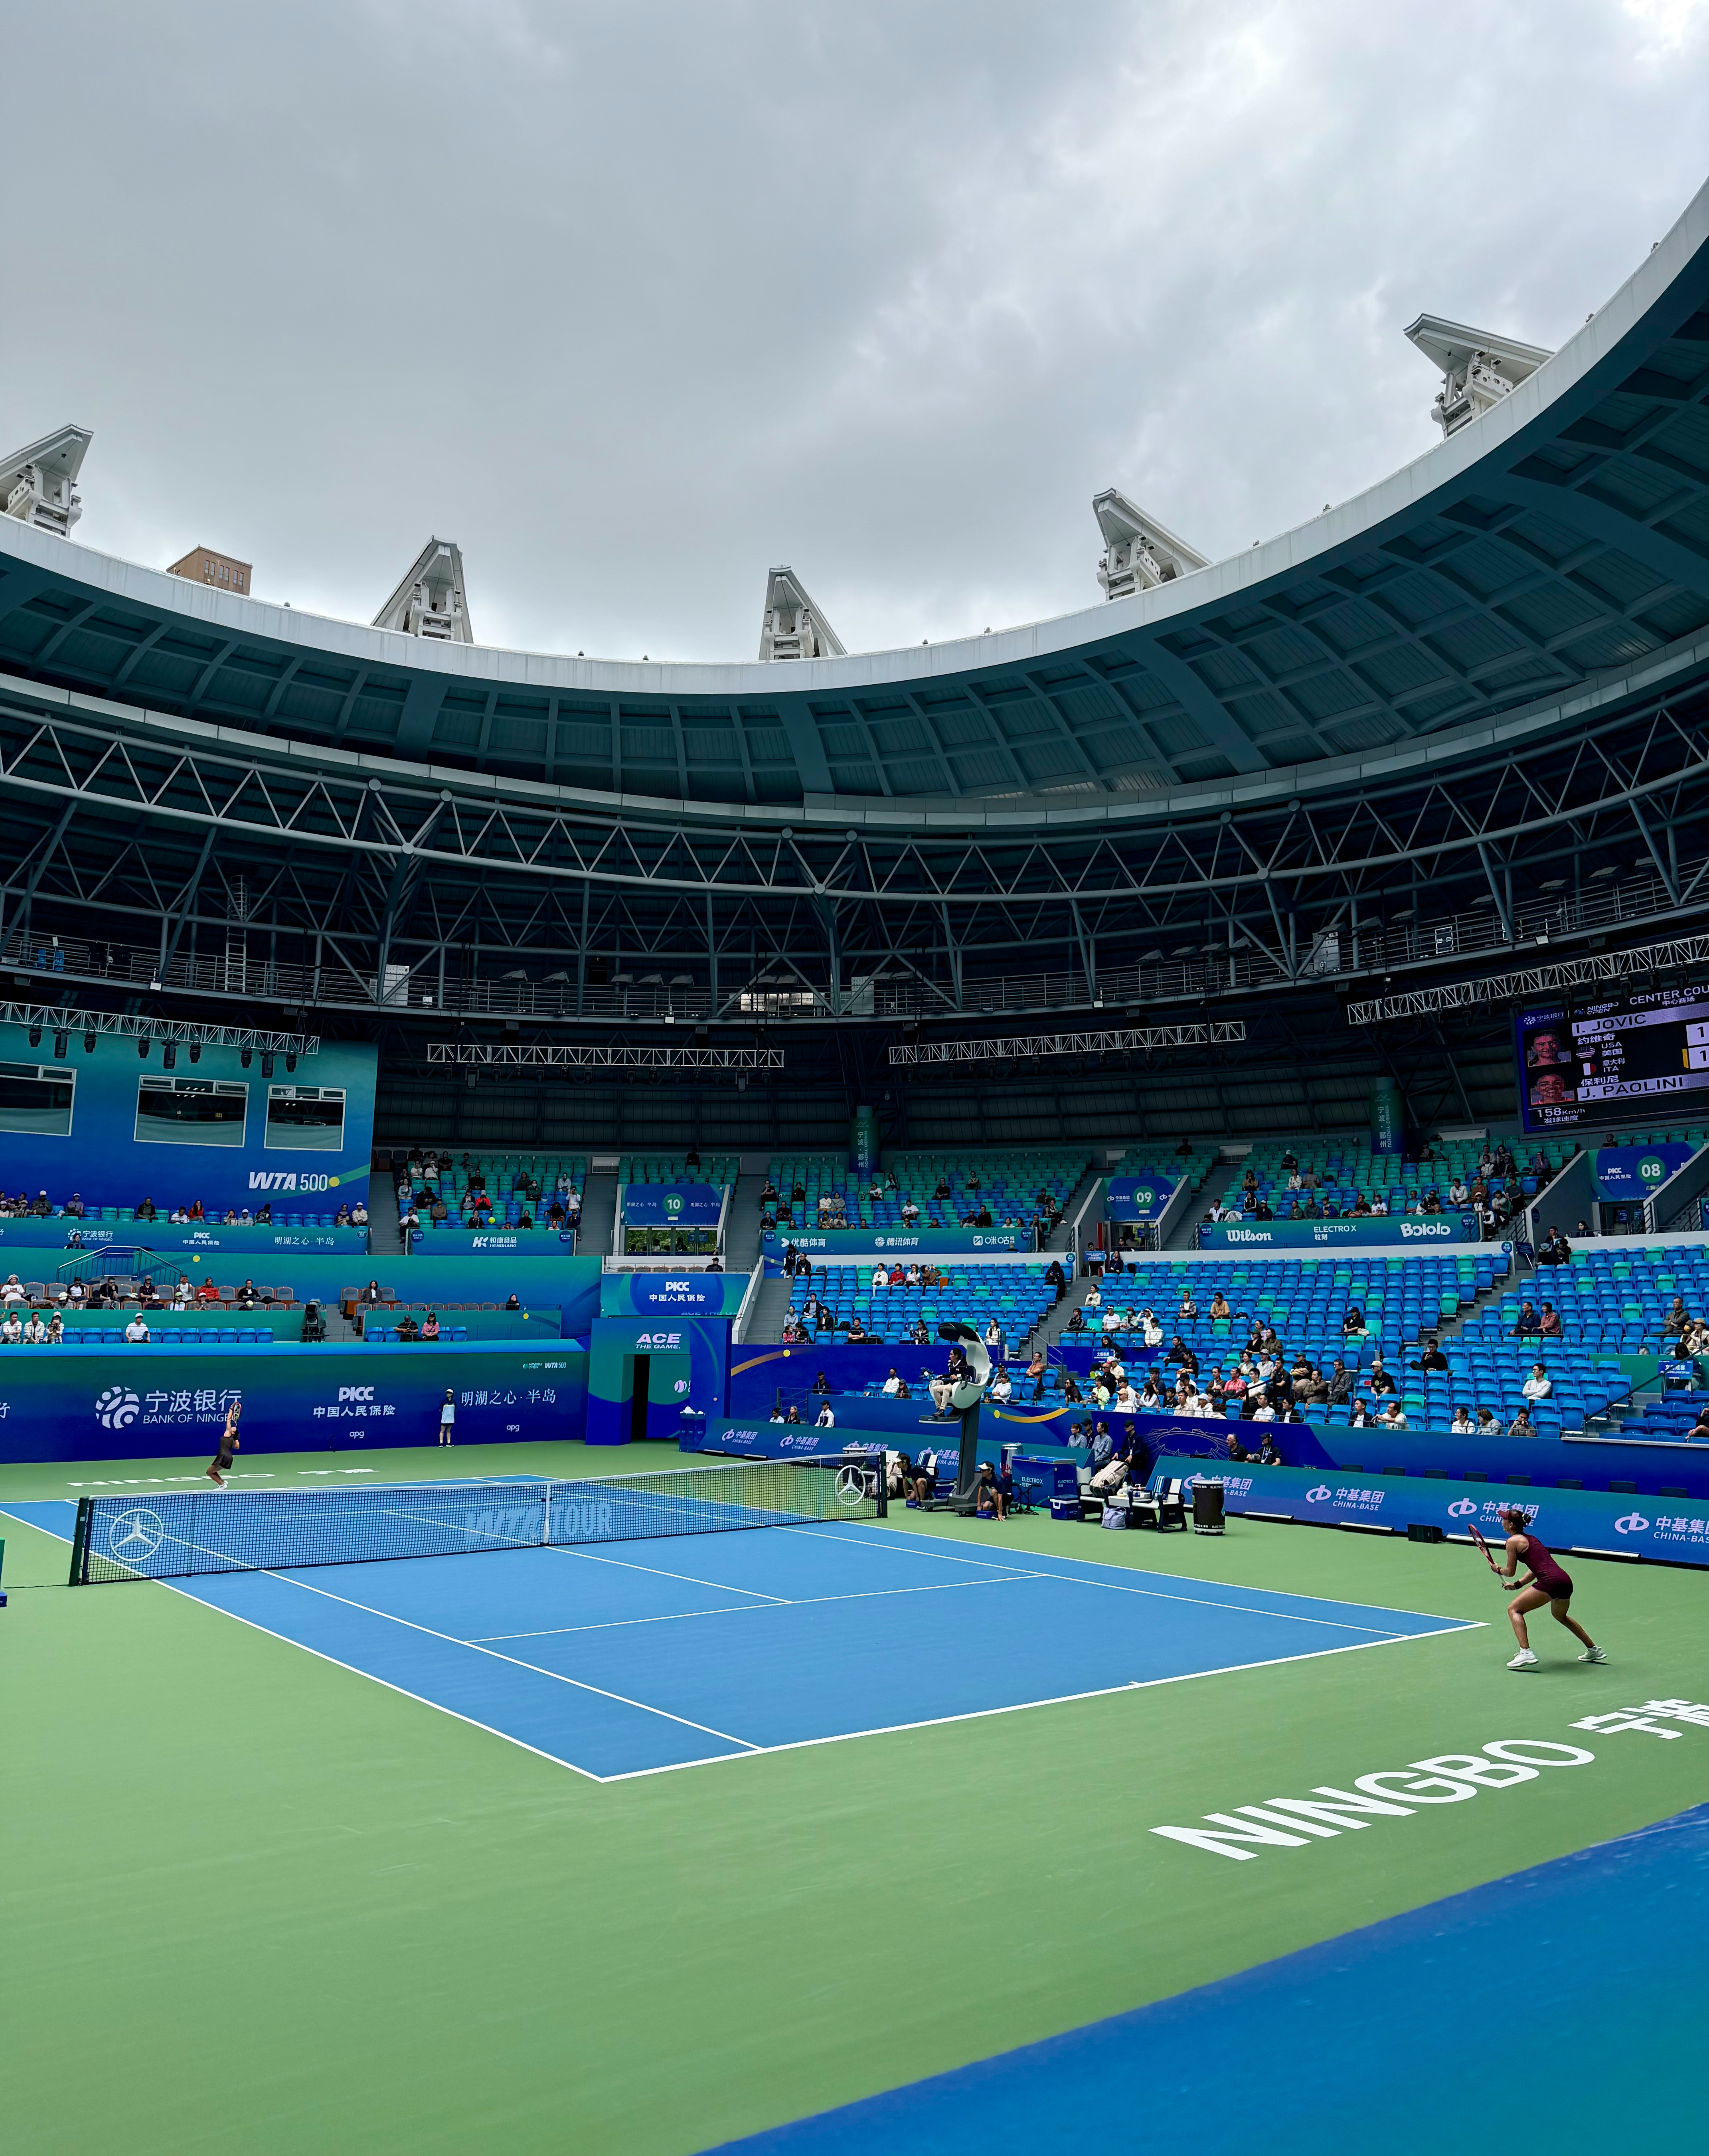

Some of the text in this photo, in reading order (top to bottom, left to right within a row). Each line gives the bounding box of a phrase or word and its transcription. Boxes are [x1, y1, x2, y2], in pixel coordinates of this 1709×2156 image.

[1630, 990, 1680, 1005] CENTER
[1576, 1015, 1647, 1034] I. JOVIC
[1697, 1026, 1704, 1038] 1
[1699, 1050, 1707, 1062] 1
[1581, 1075, 1619, 1086] 保利尼
[1581, 1077, 1683, 1098] J. PAOLINI
[1641, 1163, 1661, 1177] 08
[249, 1172, 328, 1191] WTA 500
[1136, 1192, 1152, 1203] 09
[668, 1199, 681, 1209] 10
[1226, 1229, 1273, 1242] Wilson
[1400, 1222, 1451, 1238] Bololo
[791, 1238, 826, 1247] 优酷体育
[886, 1237, 919, 1246] 腾讯体育
[666, 1281, 690, 1291] PICC
[636, 1334, 681, 1343] ACE
[338, 1386, 374, 1402] PICC
[461, 1388, 556, 1406] 明湖之心·半岛
[145, 1389, 241, 1413] 宁波银行
[313, 1405, 396, 1418] 中国人民保险
[143, 1413, 228, 1424] BANK OF NING
[735, 1430, 758, 1440] 中基集团
[795, 1435, 819, 1446] 中基集团
[1336, 1487, 1385, 1504] 中基集团
[1333, 1501, 1380, 1511] CHINA-BASE
[1147, 1739, 1595, 1861] NINGBO
